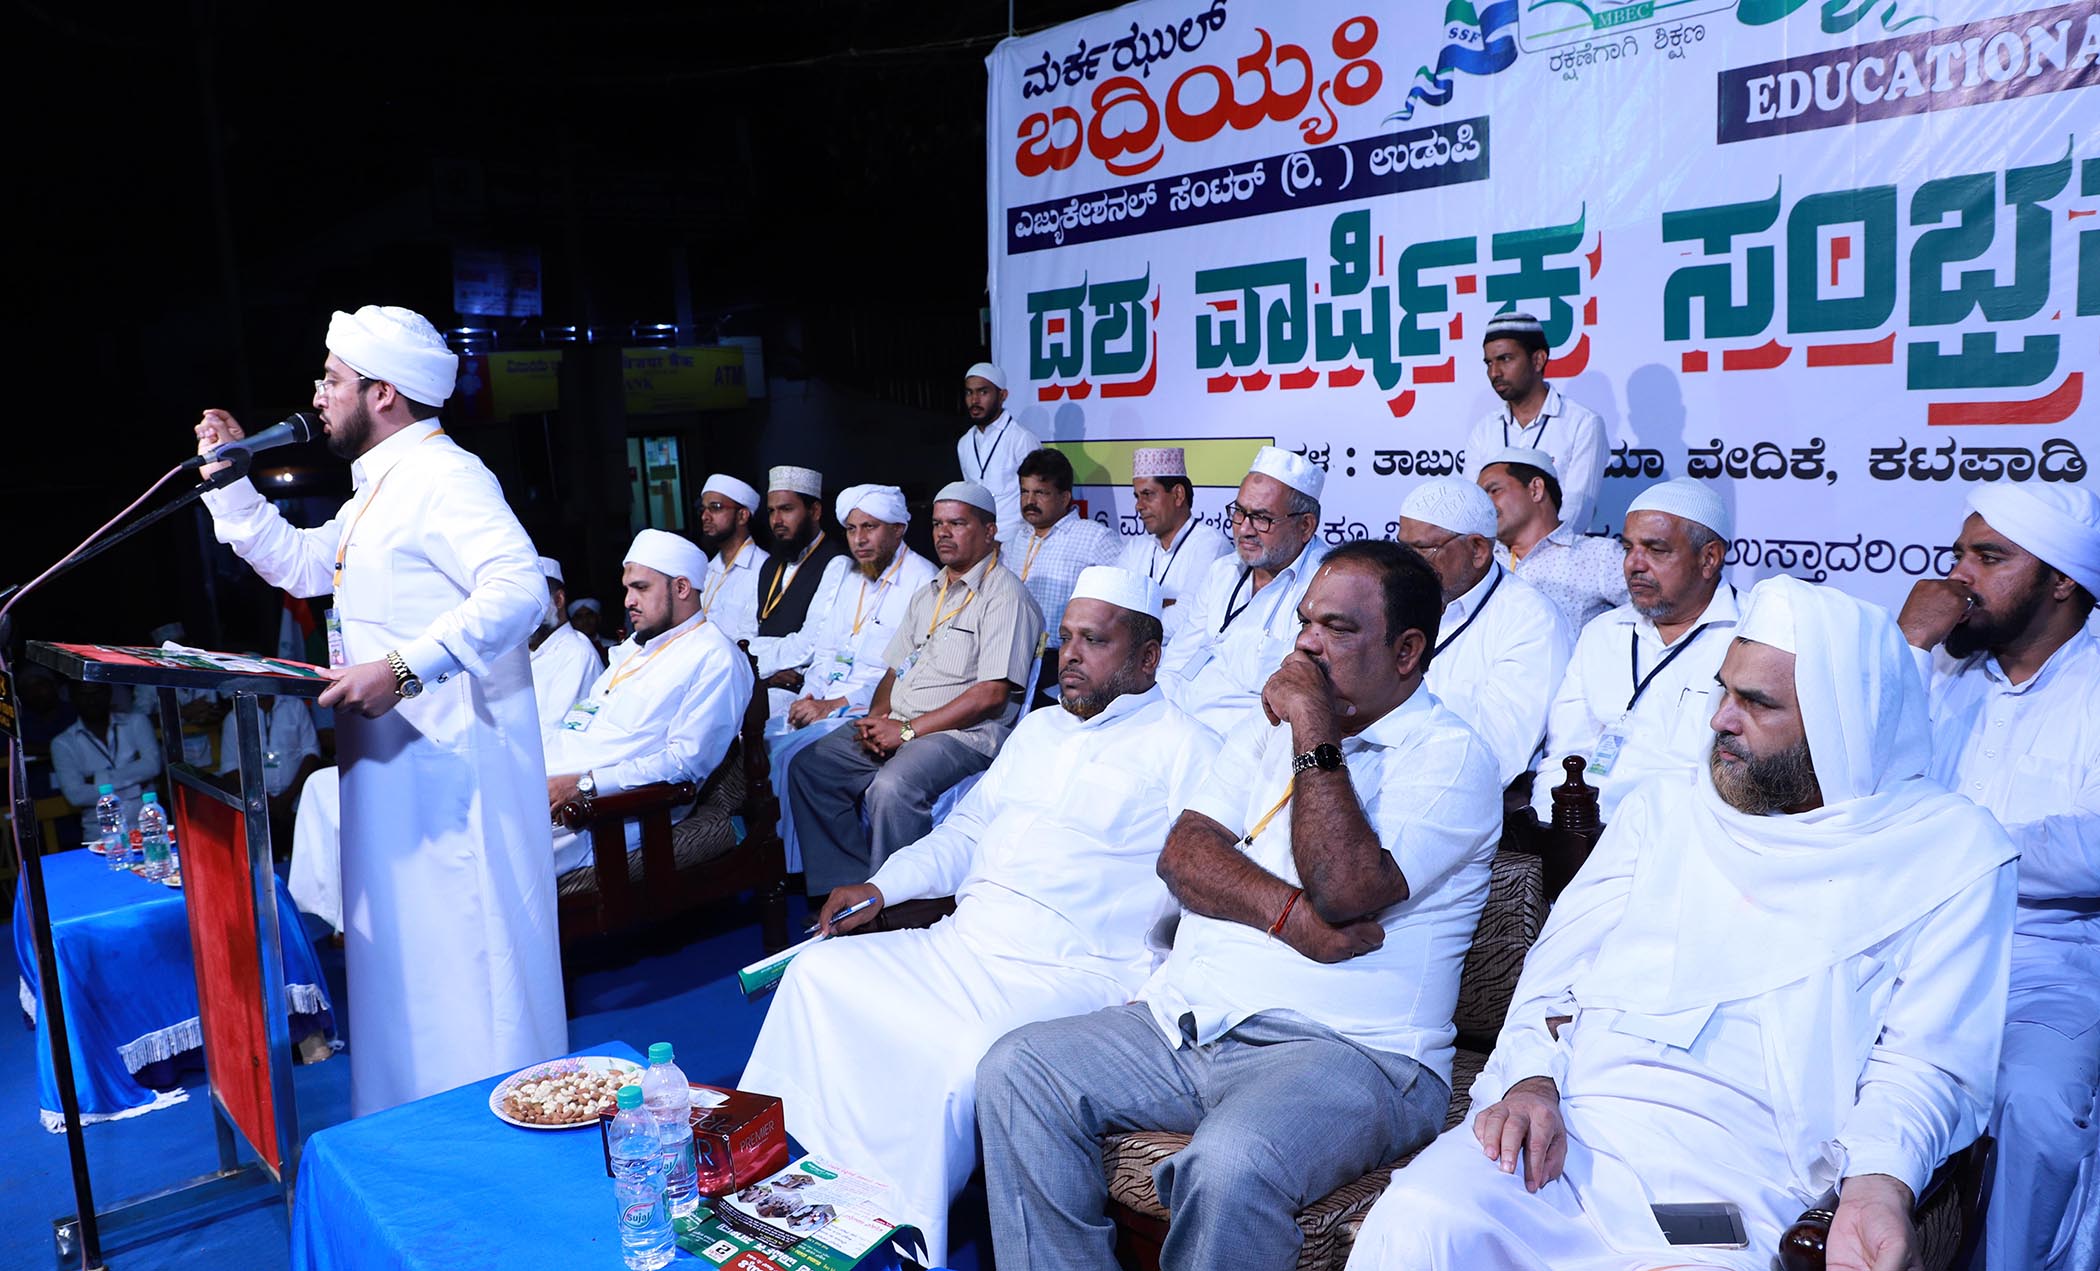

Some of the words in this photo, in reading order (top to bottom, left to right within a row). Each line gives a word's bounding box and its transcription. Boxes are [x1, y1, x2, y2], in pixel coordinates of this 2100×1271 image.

[1599, 3, 1650, 27] MBEC
[1448, 27, 1481, 44] SSF
[1549, 35, 1639, 81] ರಕ್ಷಣೆಗಾಗಿ
[1654, 23, 1706, 60] ಶಿಕ್ಷಣ
[1169, 162, 1266, 212] ಸೆಂಟರ್
[1369, 124, 1481, 176] ಉಡುಪಿ
[1027, 261, 1160, 401] ದಶ
[1662, 133, 2100, 426] ಸಂಭ್ರ
[1868, 436, 2088, 483] ಕಟಪಾಡಿ
[740, 1120, 776, 1152] PREMIER
[626, 1211, 650, 1224] Sujal
